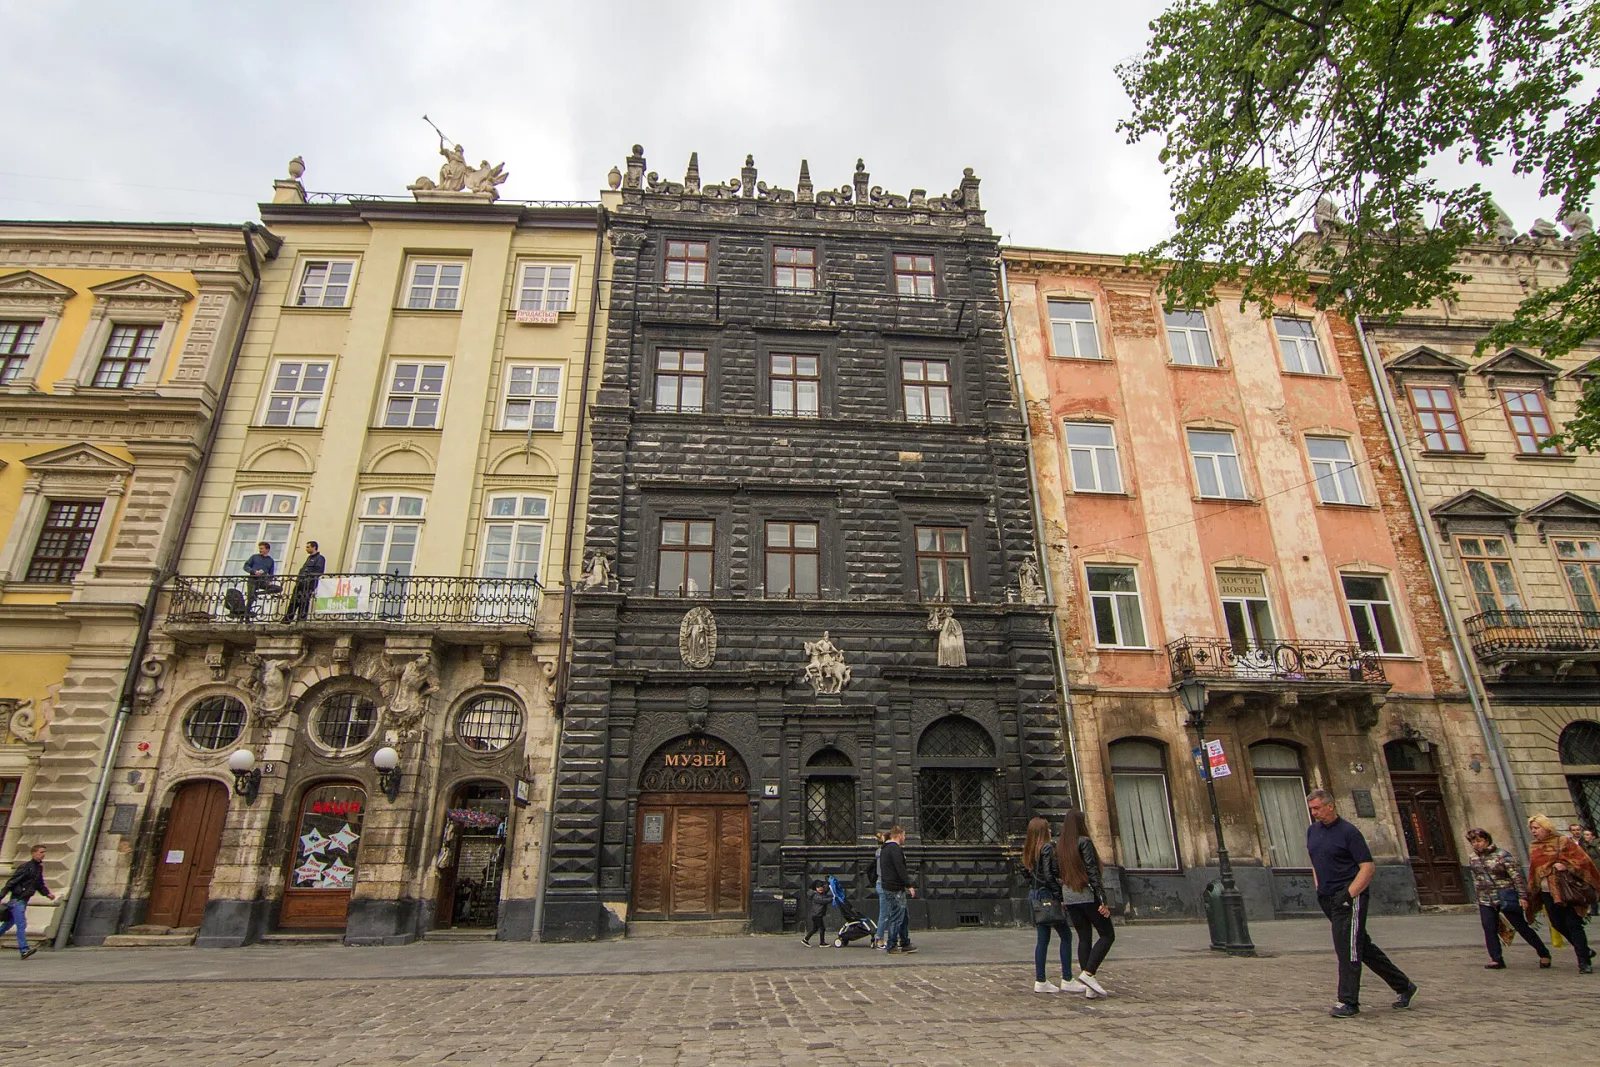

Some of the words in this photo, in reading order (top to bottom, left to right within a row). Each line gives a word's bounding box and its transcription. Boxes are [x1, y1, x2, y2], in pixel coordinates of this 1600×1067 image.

[1220, 576, 1258, 585] ХОСТЕЛ
[333, 576, 352, 598] Art
[1222, 585, 1261, 594] HOSTEL
[664, 750, 727, 767] МУЗЕЙ
[266, 763, 273, 773] 3
[768, 786, 775, 795] 4
[311, 801, 361, 815] АКЦІЯ
